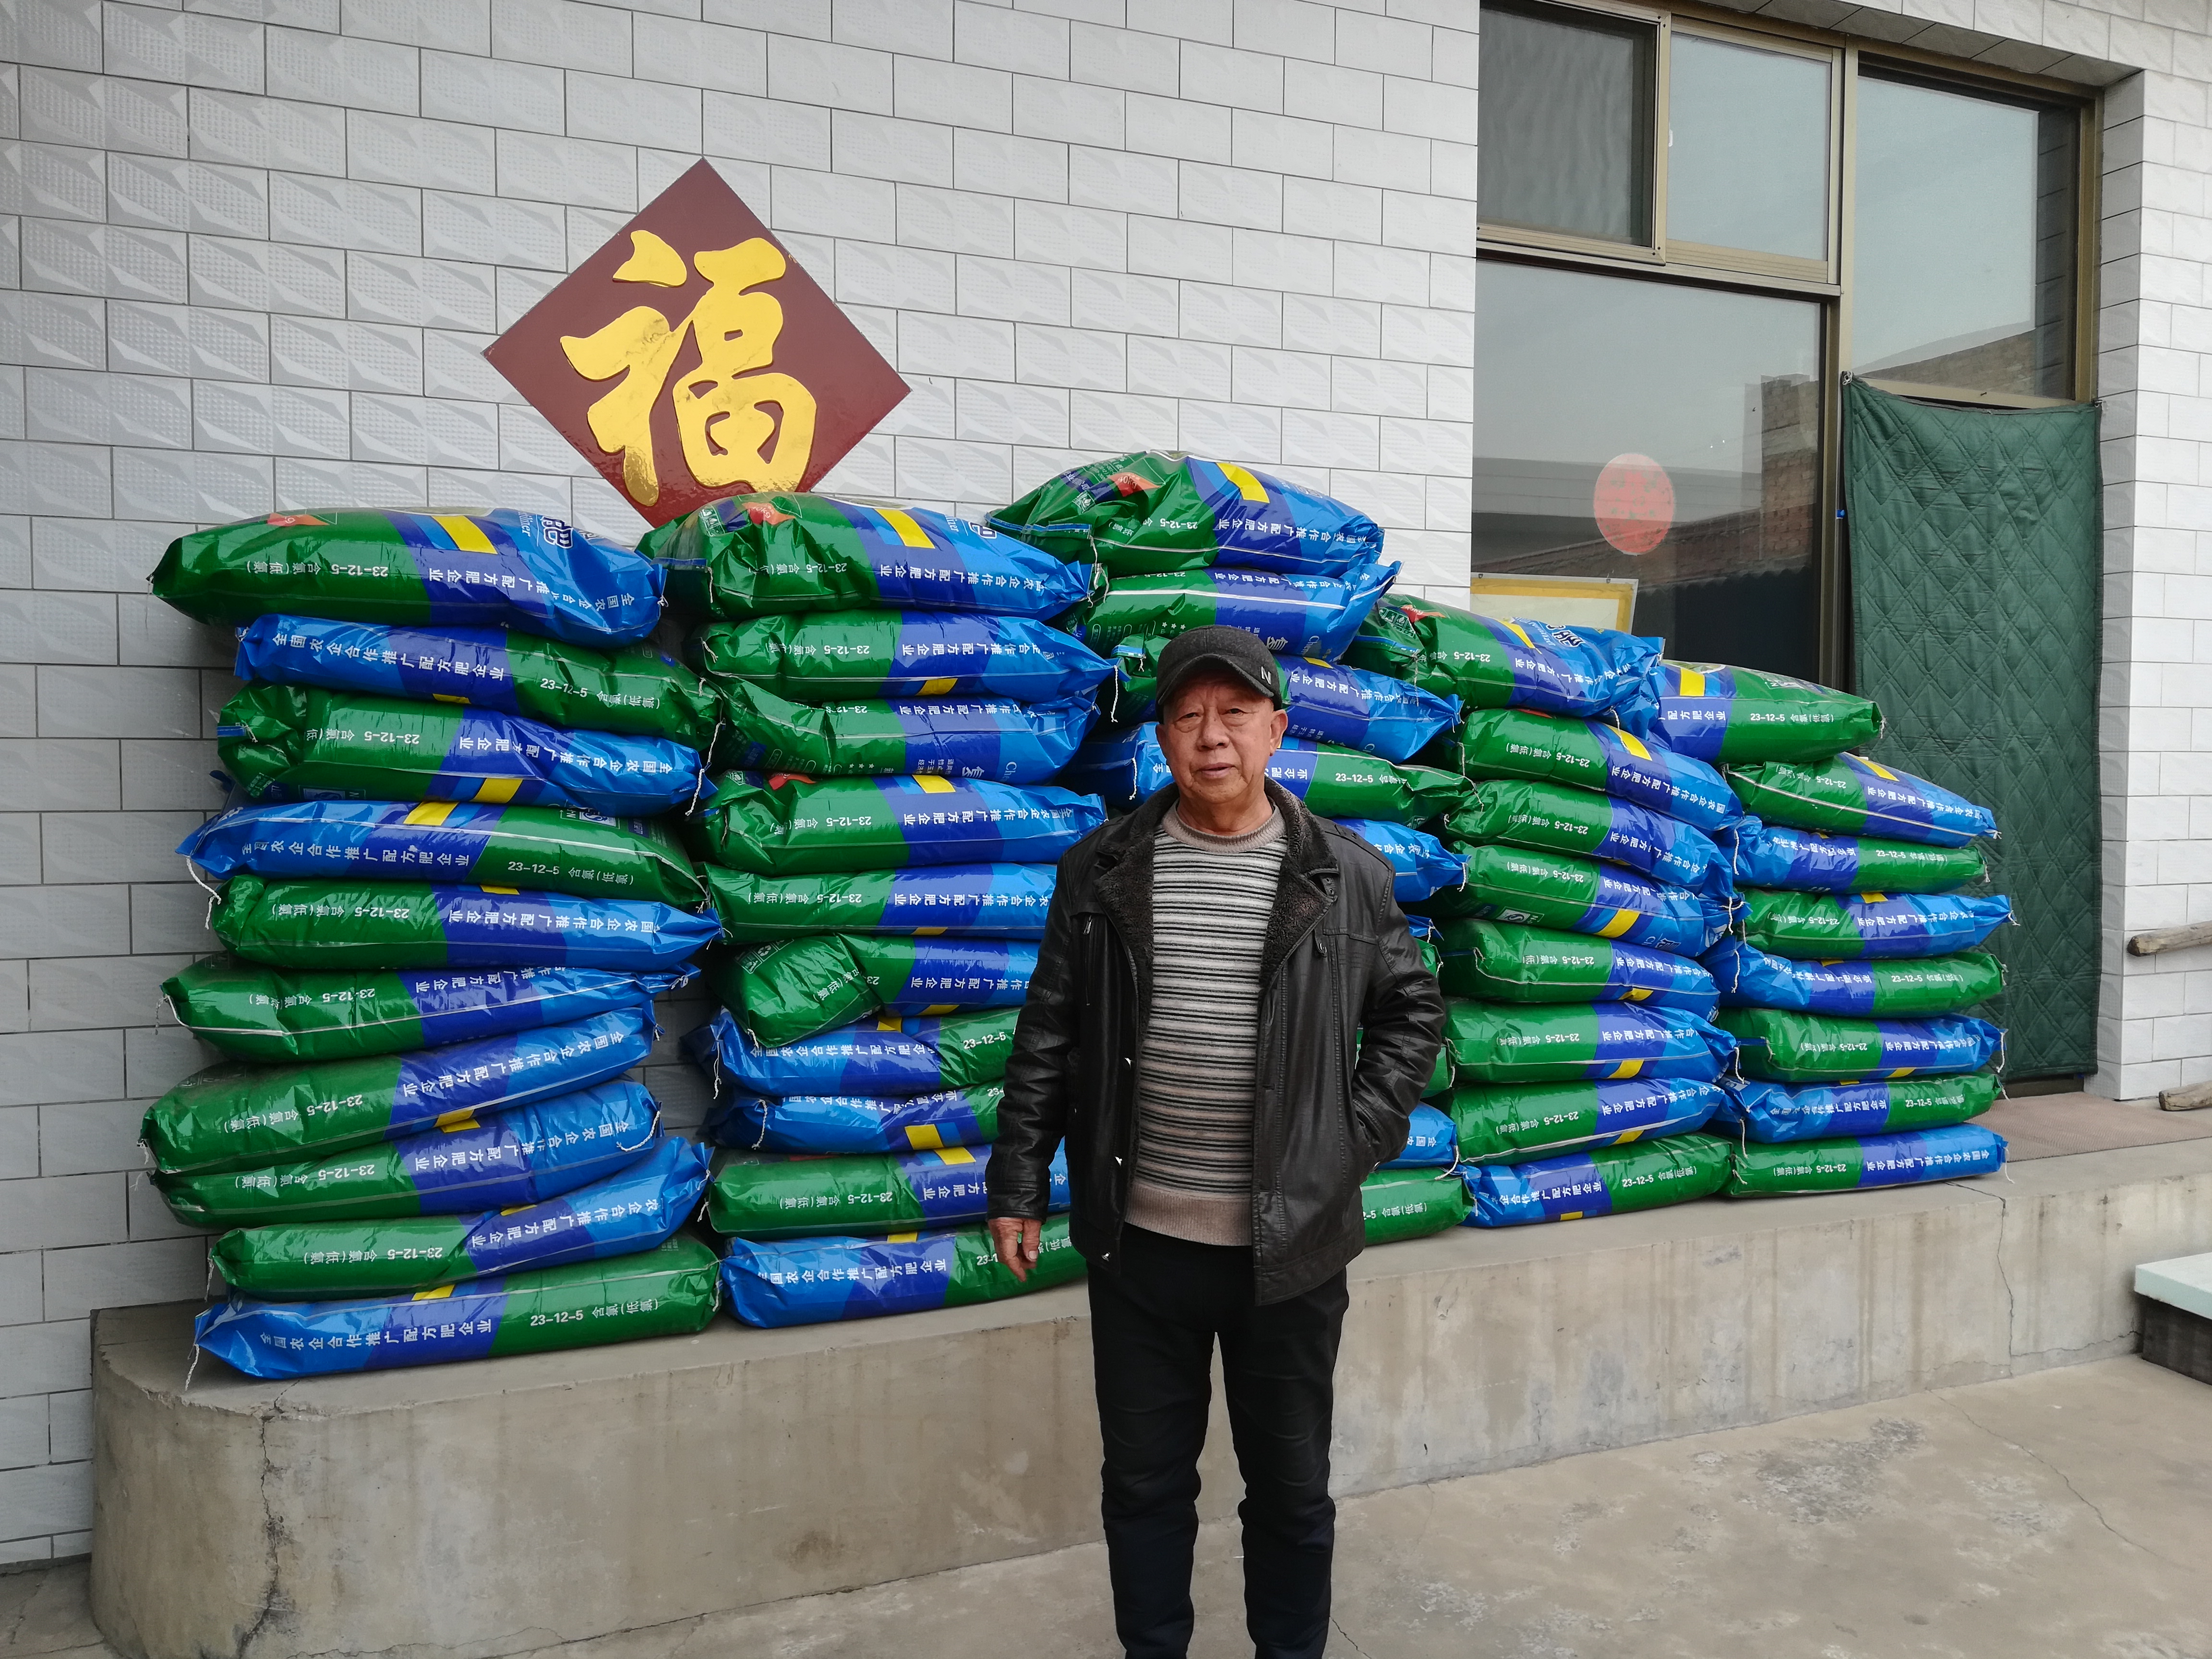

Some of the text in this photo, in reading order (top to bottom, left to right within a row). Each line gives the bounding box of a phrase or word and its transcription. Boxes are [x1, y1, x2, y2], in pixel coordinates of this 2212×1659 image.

[560, 230, 817, 506] 福
[1160, 517, 1198, 529] 23-12-5
[246, 560, 322, 575] 含氯(低氯)
[331, 563, 388, 577] 23-12-5
[823, 645, 870, 655] 23-12-5
[1453, 651, 1491, 663] 23-12-5
[272, 632, 661, 709] 全国农企合作推广配方肥企业 23-12-5 含氯(低氯)
[1750, 713, 1786, 722] 23-12-5
[364, 731, 420, 745] 23-12-5
[459, 736, 673, 774] 全国农企合作推广配方肥企业
[1505, 742, 1552, 760] 含氯(低氯)
[1555, 752, 1591, 768] 23-12-5
[1335, 772, 1373, 783] 23-12-5
[1815, 775, 1847, 789] 23-12-5
[826, 816, 872, 827] 23-12-5
[1554, 820, 1589, 835] 23-12-5
[1875, 850, 1906, 859] 23-12-5
[241, 840, 634, 885] 全国农企合作推广配方肥企业 23-12-5 含氯(低氯)
[1552, 869, 1584, 883] 23-12-5
[748, 891, 809, 904] 含氯(低氯)
[816, 893, 862, 904] 23-12-5
[272, 903, 346, 918] 含氯(低氯)
[354, 906, 409, 919] 23-12-5
[1808, 916, 1840, 926] 23-12-5
[1562, 956, 1595, 965] 23-12-5
[1891, 974, 1923, 983] 23-12-5
[322, 988, 376, 1003] 23-12-5
[962, 1031, 1007, 1050] 23-12-5
[1545, 1033, 1580, 1044] 23-12-5
[1839, 1042, 1868, 1052] 23-12-5
[223, 1031, 625, 1134] 全国农企合作推广配方肥企业 23-12-5 含氯(低氯)
[1905, 1098, 1932, 1108] 23-12-5
[1543, 1111, 1579, 1125] 23-12-5
[235, 1119, 630, 1189] 全国农企合作推广配方肥企业 23-12-5 含氯(低氯)
[1865, 1149, 1990, 1172] 全国农企合作推广配方肥企业
[1816, 1163, 1847, 1174] 23-12-5
[1621, 1174, 1654, 1188] 23-12-5
[779, 1194, 840, 1210] 含氯(低氯)
[847, 1191, 893, 1205] 23-12-5
[1381, 1202, 1428, 1218] 含氯(低氯)
[303, 1249, 378, 1265] 含氯(低氯)
[386, 1247, 444, 1260] 23-12-5
[259, 1298, 659, 1351] 全国农企合作推广配方肥企业 23-12-5 含氯(低氯)
